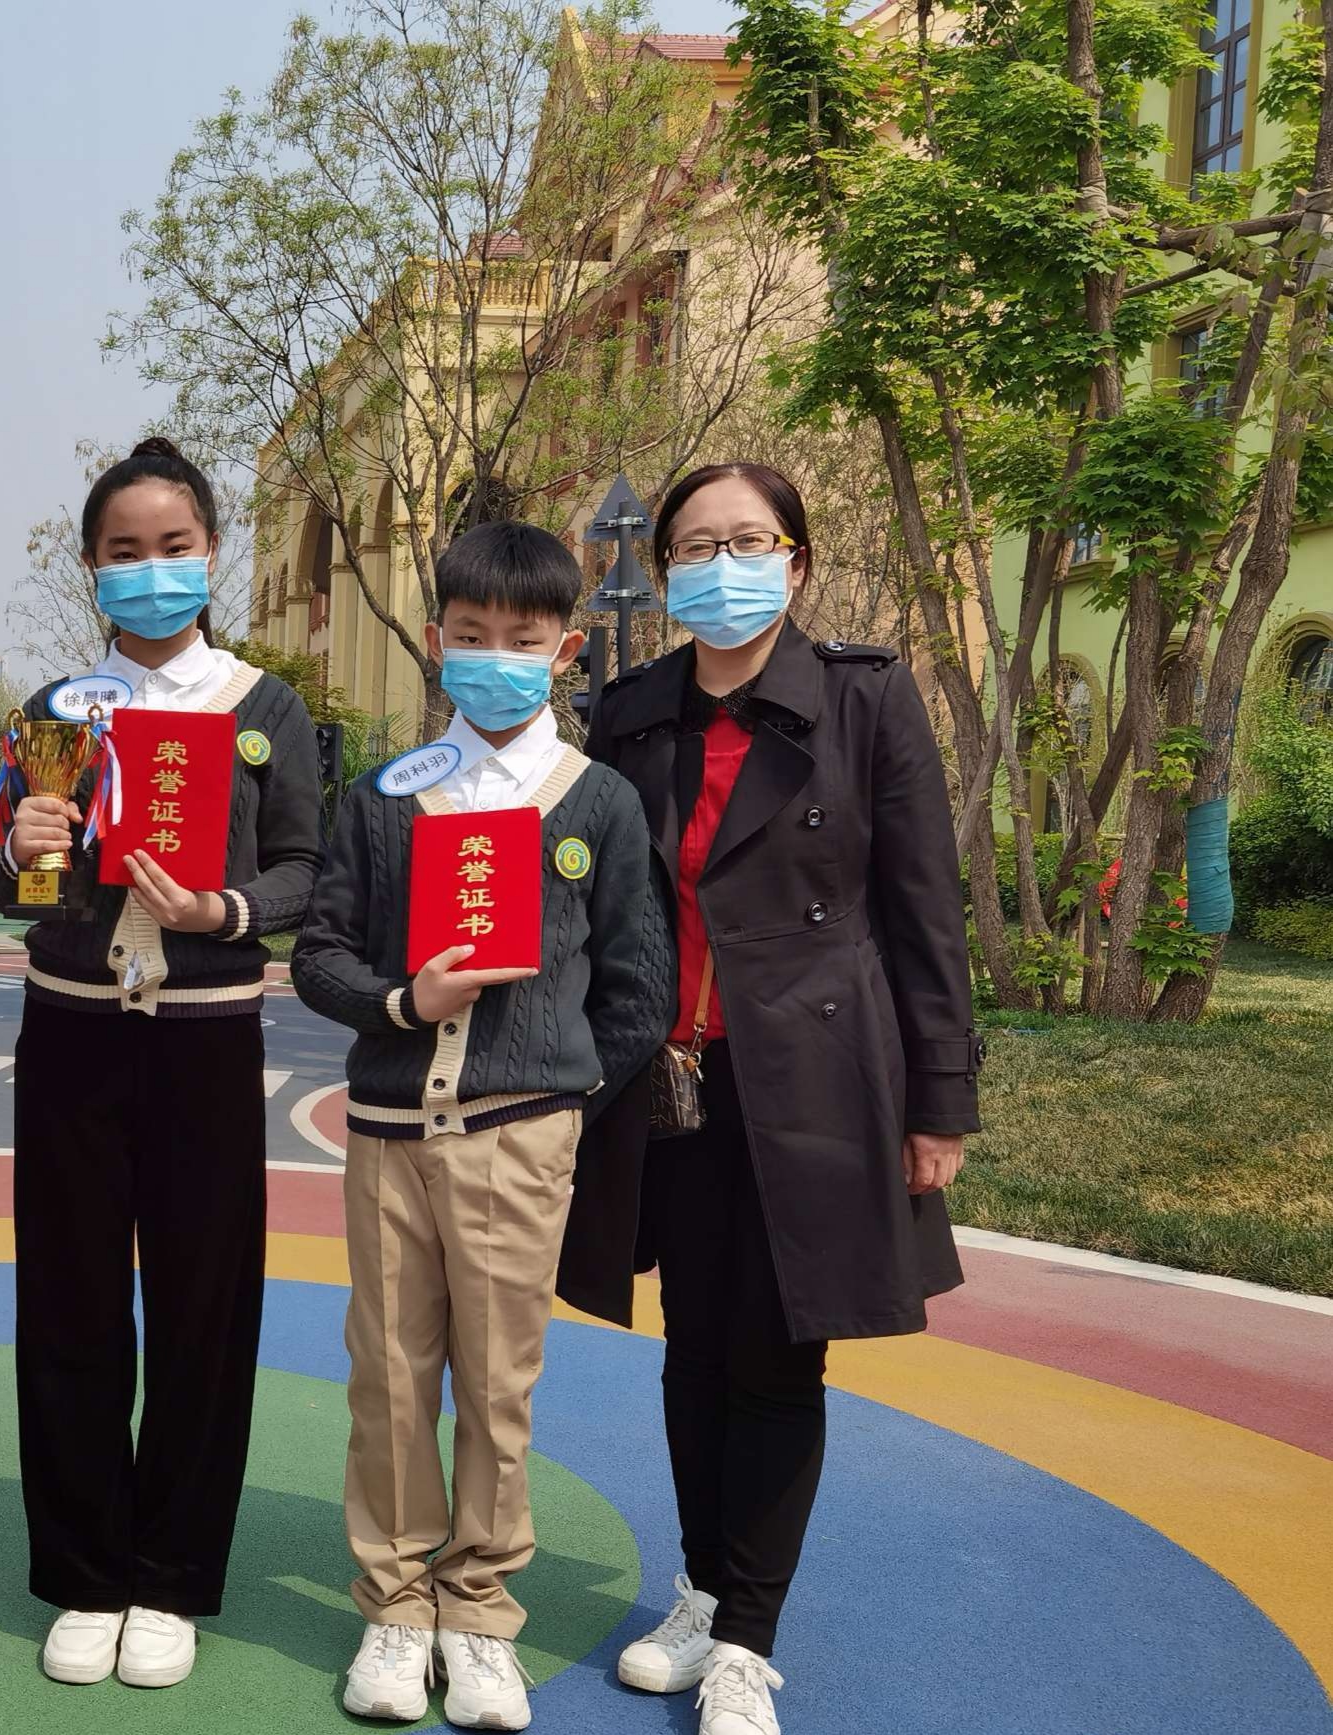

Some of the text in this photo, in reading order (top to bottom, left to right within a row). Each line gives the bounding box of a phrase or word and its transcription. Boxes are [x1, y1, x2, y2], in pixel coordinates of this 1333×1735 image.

[64, 689, 118, 707] 徐晨曦
[145, 740, 188, 853] 荣誉证书
[393, 752, 448, 786] 周科羽
[456, 835, 495, 937] 荣誉证书
